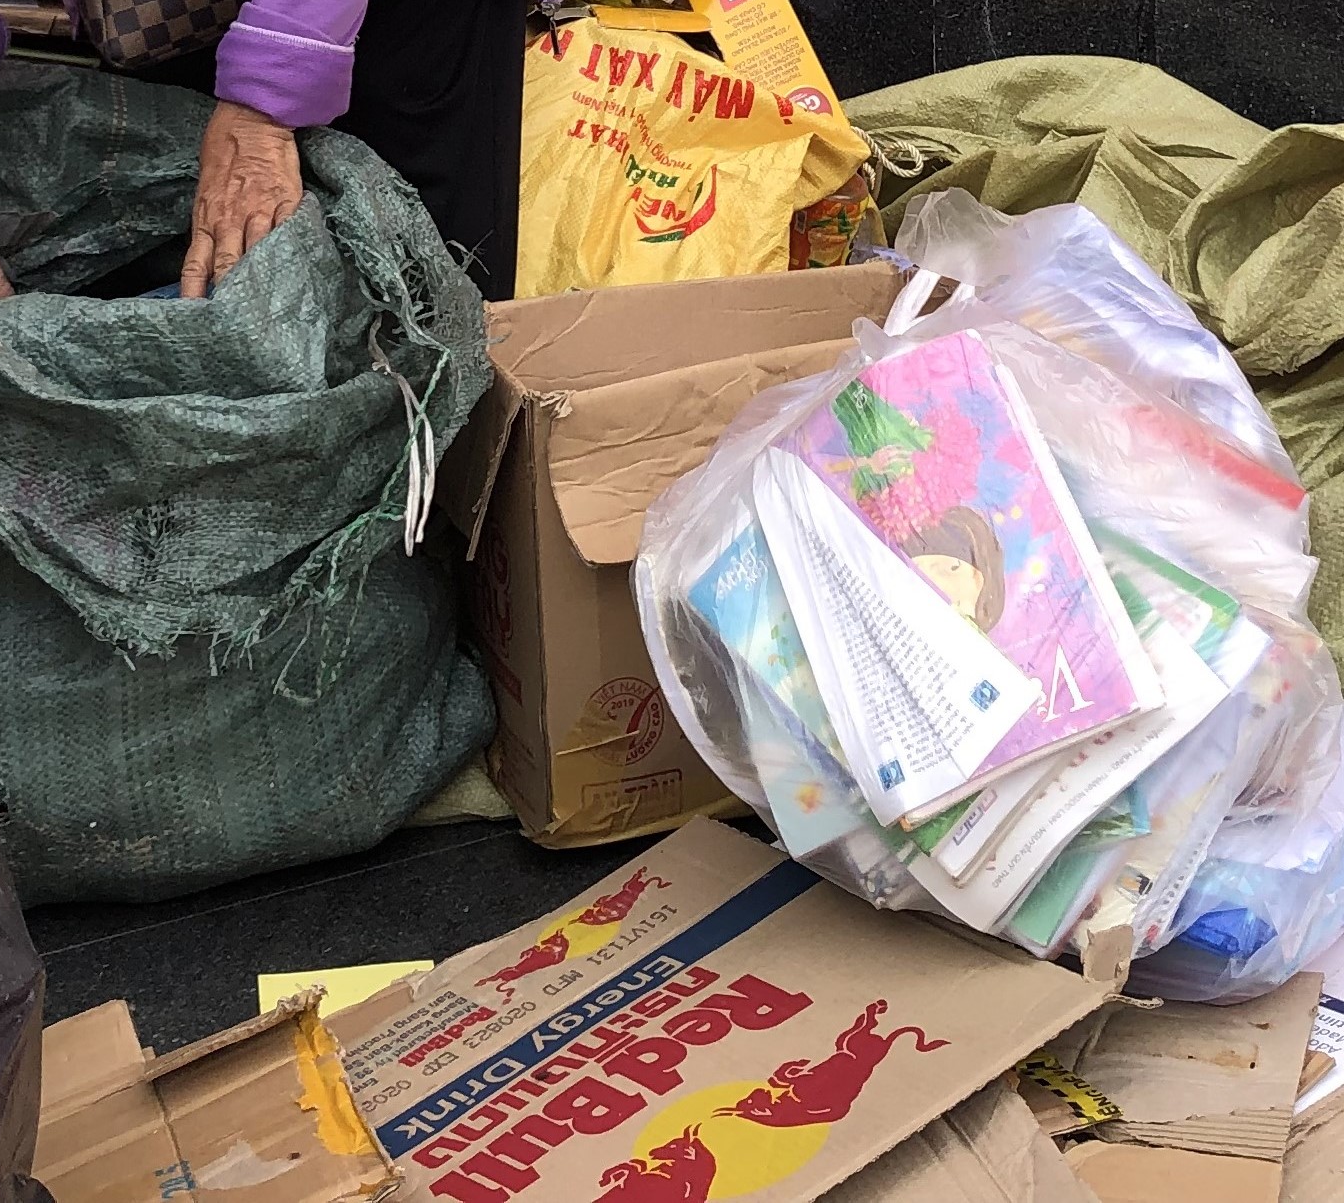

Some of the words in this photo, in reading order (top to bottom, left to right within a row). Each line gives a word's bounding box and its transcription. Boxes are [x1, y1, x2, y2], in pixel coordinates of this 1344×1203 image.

[579, 43, 661, 93] XÁT
[665, 61, 755, 123] MÁY
[611, 699, 635, 711] 2019
[587, 904, 678, 966] 161VT131
[533, 955, 685, 1052] Energy
[543, 970, 584, 997] MFD
[452, 1006, 498, 1031] Red
[605, 974, 814, 1096] Red
[398, 1028, 453, 1068] Bull
[422, 1052, 460, 1077] EXP
[394, 1057, 528, 1139] Drink
[429, 1076, 648, 1203] Bull
